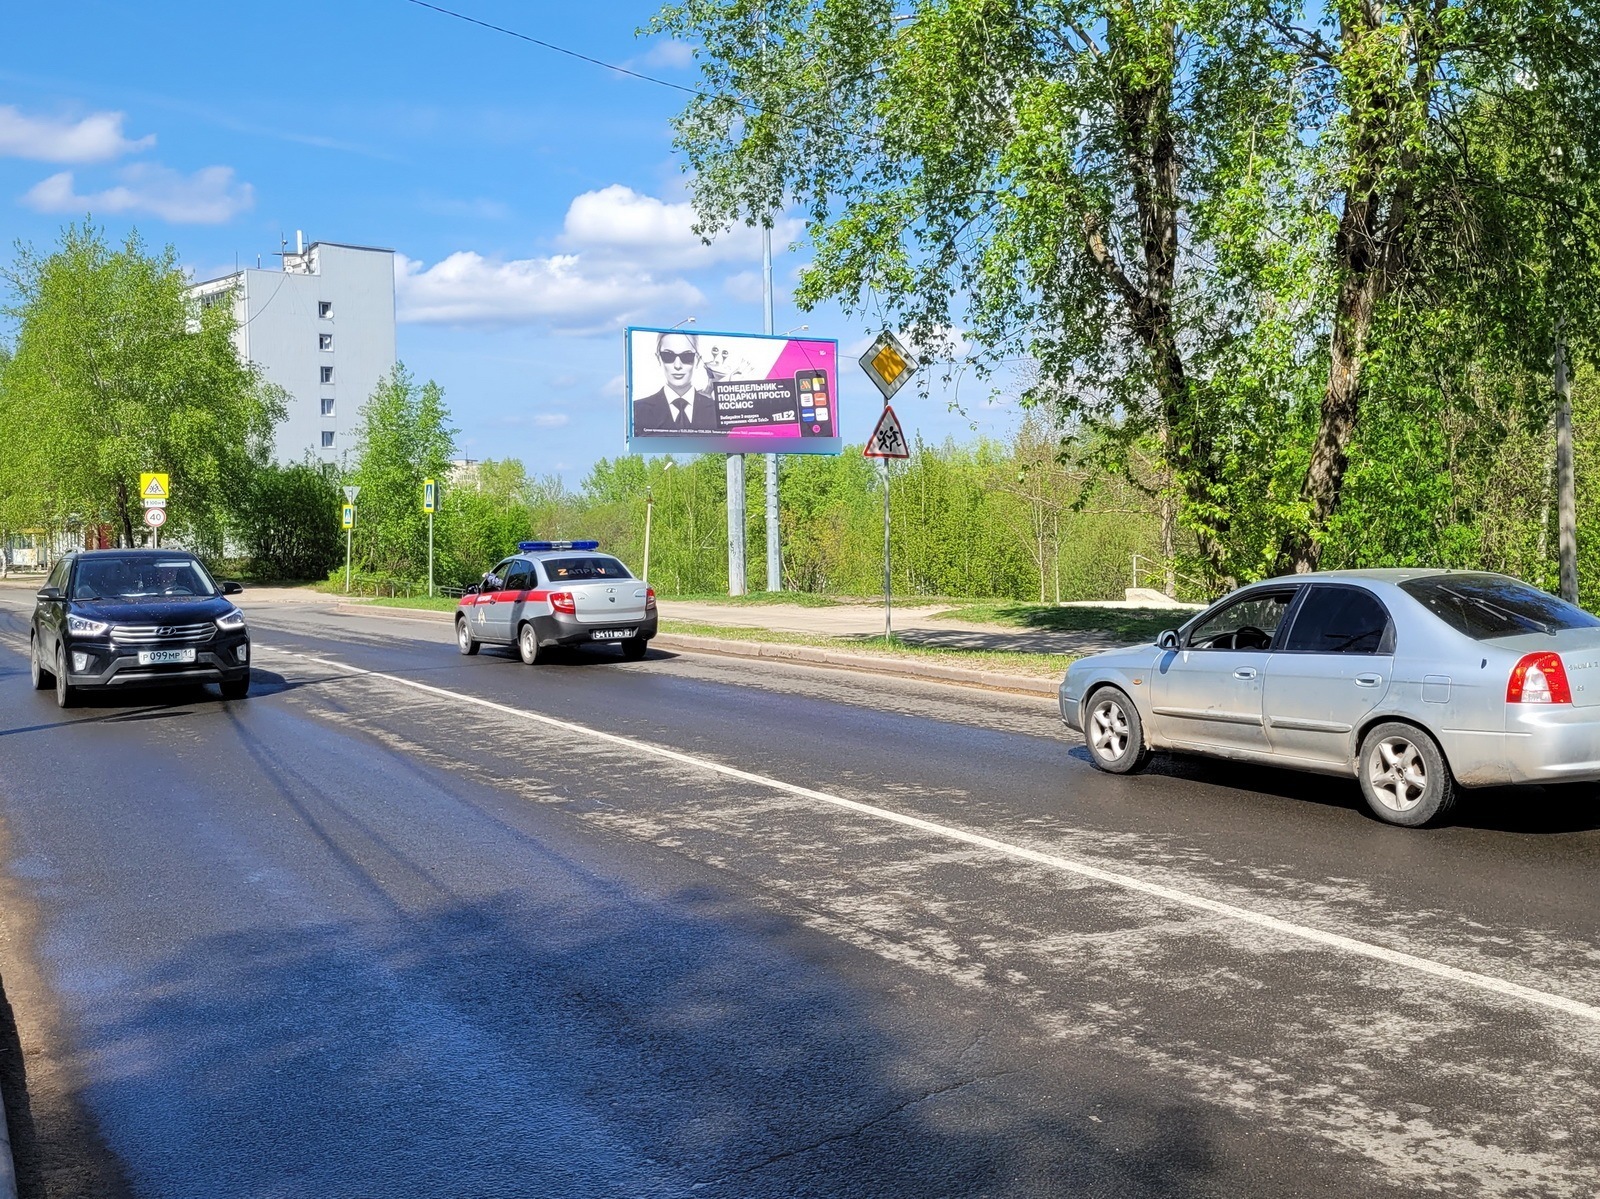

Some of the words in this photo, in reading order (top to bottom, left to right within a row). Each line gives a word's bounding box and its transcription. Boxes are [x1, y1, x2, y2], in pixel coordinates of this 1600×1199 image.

[717, 383, 776, 393] ПОНЕДЕЛЬНИК
[718, 392, 757, 402] ПОДАРКИ
[758, 390, 790, 399] ПРОСТО
[718, 401, 754, 410] КОСМОС
[772, 410, 796, 422] TELE2
